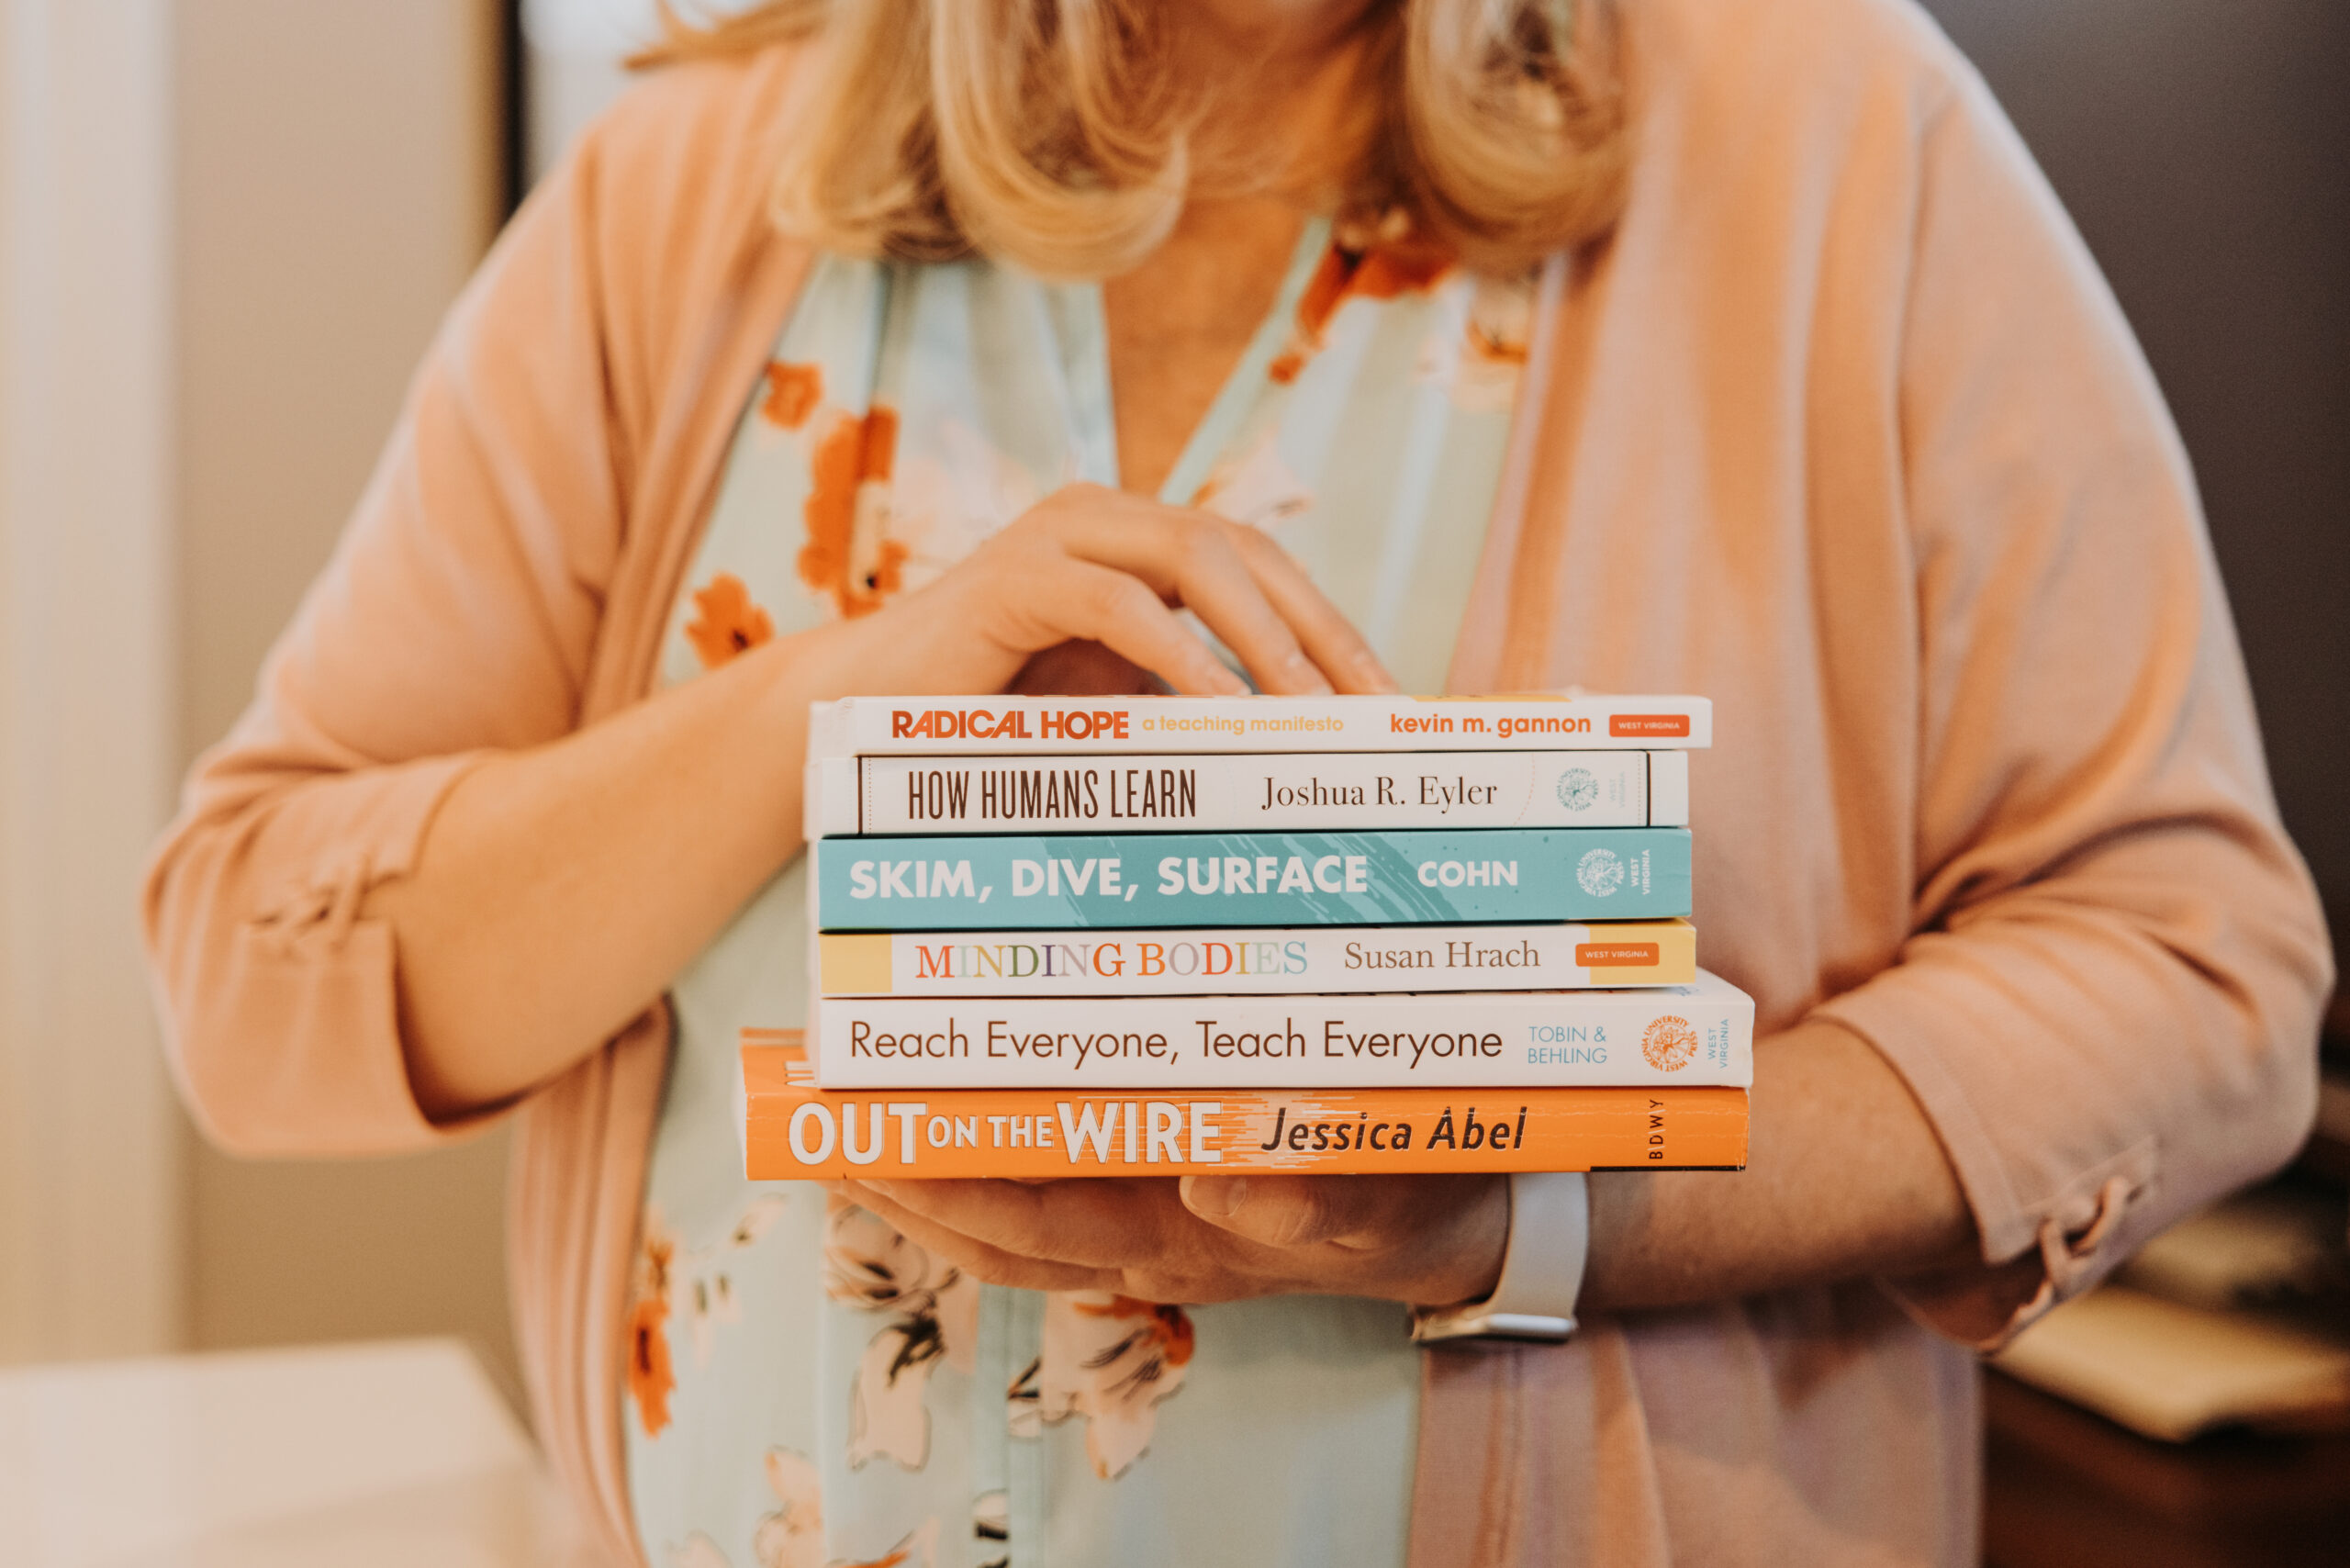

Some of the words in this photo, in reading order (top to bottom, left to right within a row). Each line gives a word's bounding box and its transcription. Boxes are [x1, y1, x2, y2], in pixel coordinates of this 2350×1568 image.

[891, 710, 1033, 739] RADICAL
[1040, 710, 1129, 739] HOPE
[1141, 719, 1156, 732] a
[1158, 714, 1246, 736] teaching
[1249, 715, 1345, 732] manifesto
[1390, 713, 1454, 734] kevin
[1462, 717, 1492, 734] m.
[1497, 717, 1592, 739] gannon
[1617, 722, 1641, 730] WEST
[1643, 722, 1681, 730] VIRGINIA
[908, 770, 970, 820] HOW
[981, 769, 1099, 819] HUMANS
[1110, 768, 1196, 818] LEARN
[1261, 777, 1365, 811] Joshua
[1376, 777, 1405, 805] R.
[1418, 776, 1498, 814] Eyler
[849, 859, 993, 904] SKIM,
[1012, 857, 1139, 902] DIVE,
[1157, 854, 1369, 896] SURFACE
[1417, 860, 1518, 889] COHN
[1630, 857, 1639, 888] WEST
[1641, 848, 1651, 896] VIRGINIA
[914, 943, 1125, 979] MINDING
[1136, 941, 1308, 977] BODIES
[1345, 942, 1435, 970] Susan
[1445, 939, 1541, 969] Hrach
[1584, 950, 1608, 958] WEST
[1611, 950, 1649, 958] VIRGINIA
[851, 1017, 968, 1058] Reach
[988, 1020, 1179, 1070] Everyone,
[1194, 1017, 1306, 1058] Teach
[1324, 1020, 1503, 1070] Everyone
[1528, 1025, 1587, 1044] TOBIN
[1594, 1025, 1607, 1044] &
[1707, 1027, 1718, 1060] WEST
[1718, 1018, 1729, 1070] VIRGINIA
[1528, 1047, 1608, 1065] BEHLING
[788, 1101, 929, 1165] OUT
[927, 1115, 979, 1148] ON
[987, 1115, 1054, 1148] THE
[1056, 1101, 1223, 1165] WIRE
[1261, 1106, 1412, 1152] Jessica
[1427, 1106, 1528, 1151] Abel
